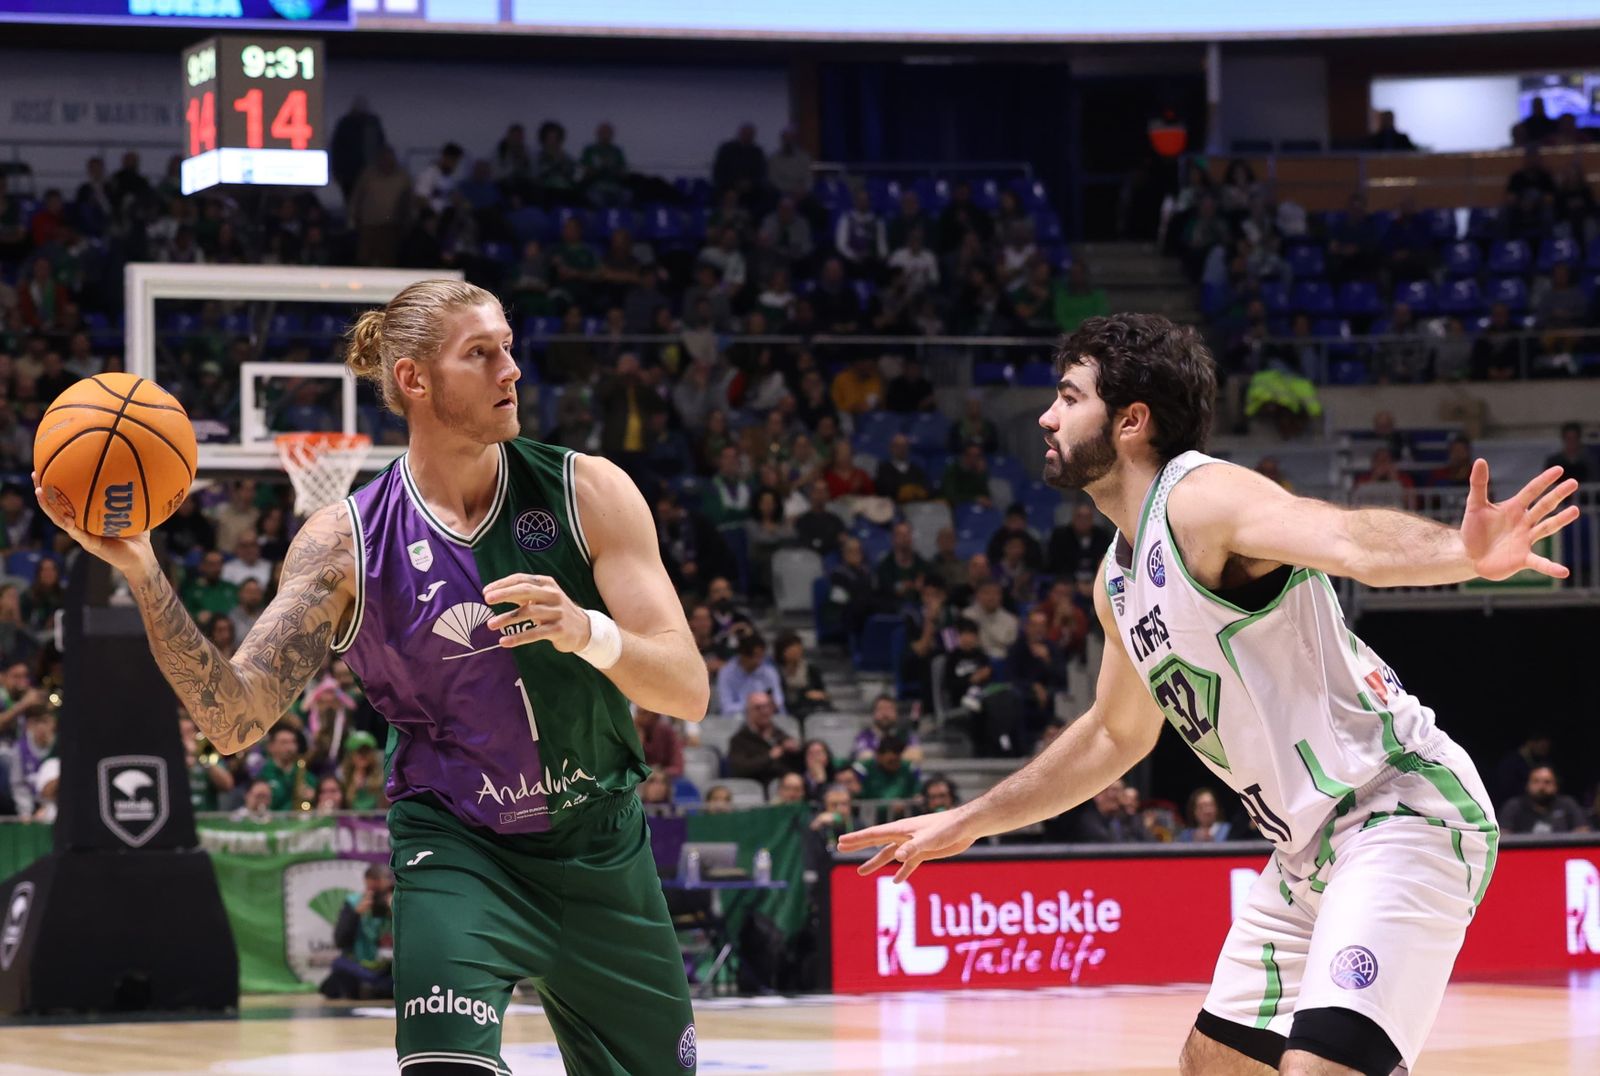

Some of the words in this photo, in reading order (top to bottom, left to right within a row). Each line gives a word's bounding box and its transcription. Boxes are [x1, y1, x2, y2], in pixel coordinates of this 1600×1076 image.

[241, 45, 315, 80] 9:31
[185, 91, 217, 157] 14
[233, 88, 313, 150] 14
[514, 677, 539, 742] 1
[1154, 668, 1213, 745] 32
[955, 937, 1043, 984] Taste
[1050, 934, 1106, 984] life
